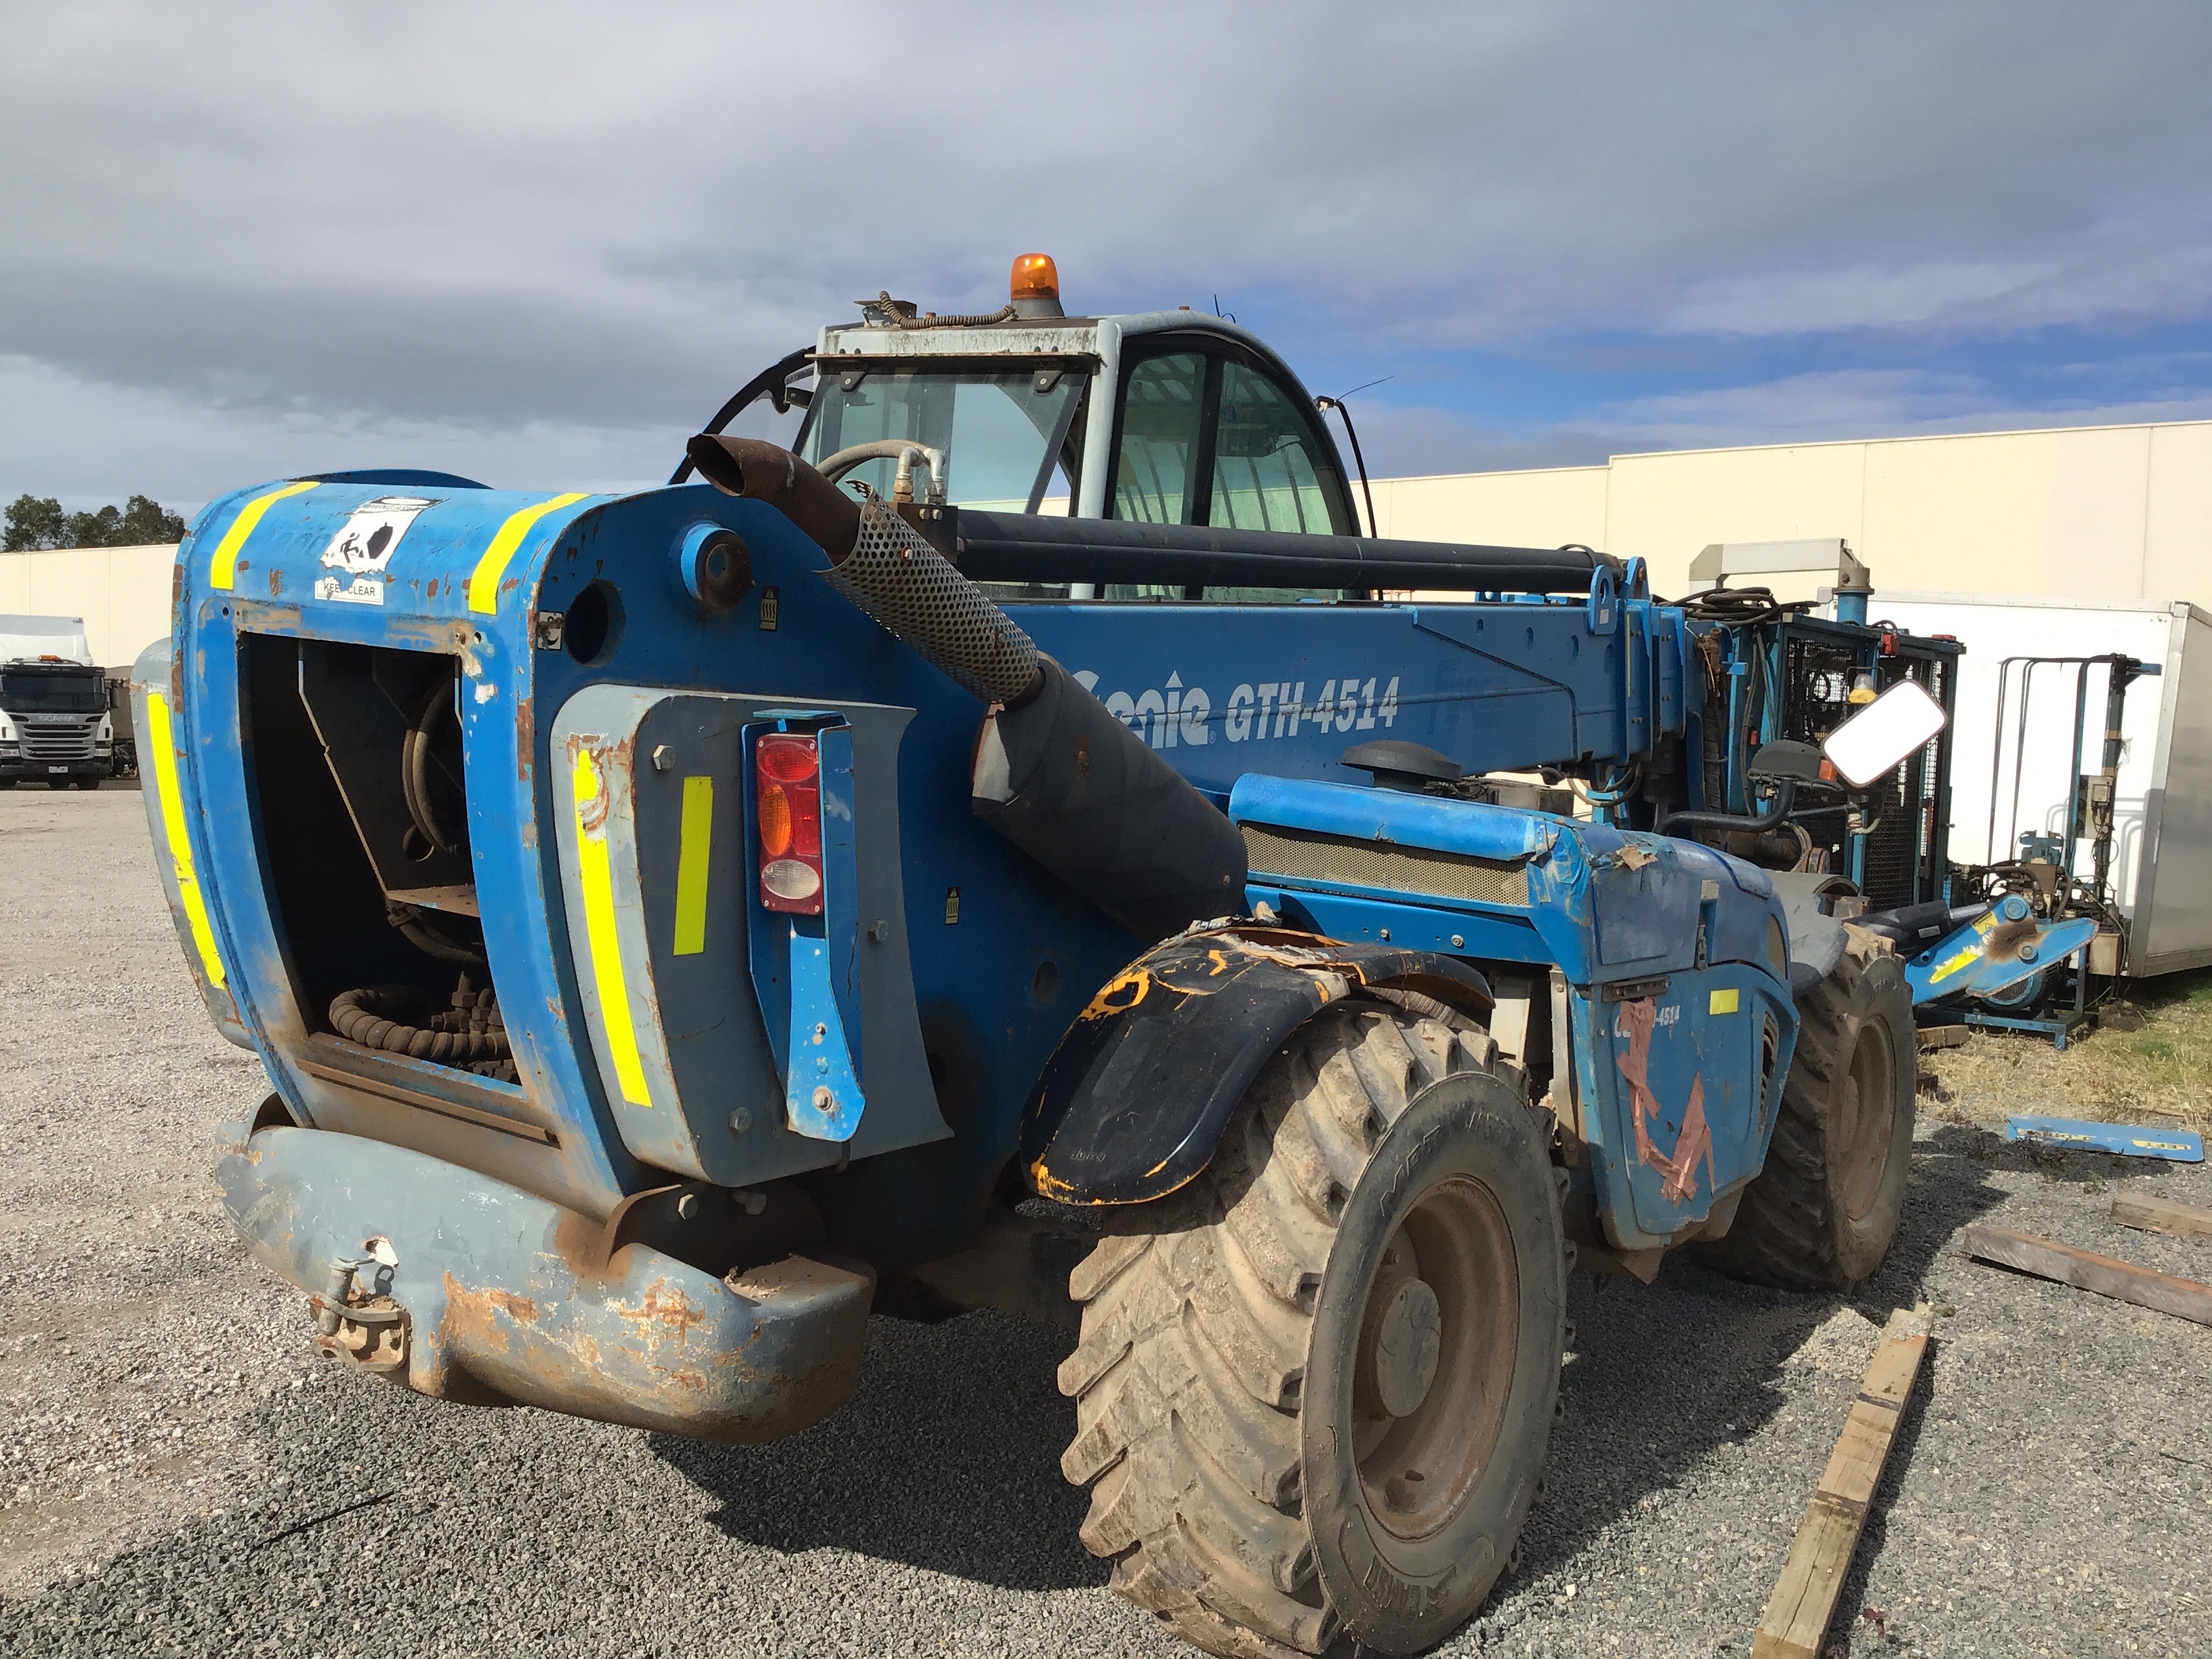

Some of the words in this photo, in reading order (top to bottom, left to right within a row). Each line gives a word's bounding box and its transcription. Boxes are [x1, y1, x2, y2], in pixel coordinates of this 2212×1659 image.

[324, 583, 342, 593] KEE
[348, 586, 375, 596] CLEAR
[1225, 676, 1399, 743] GTH-4514
